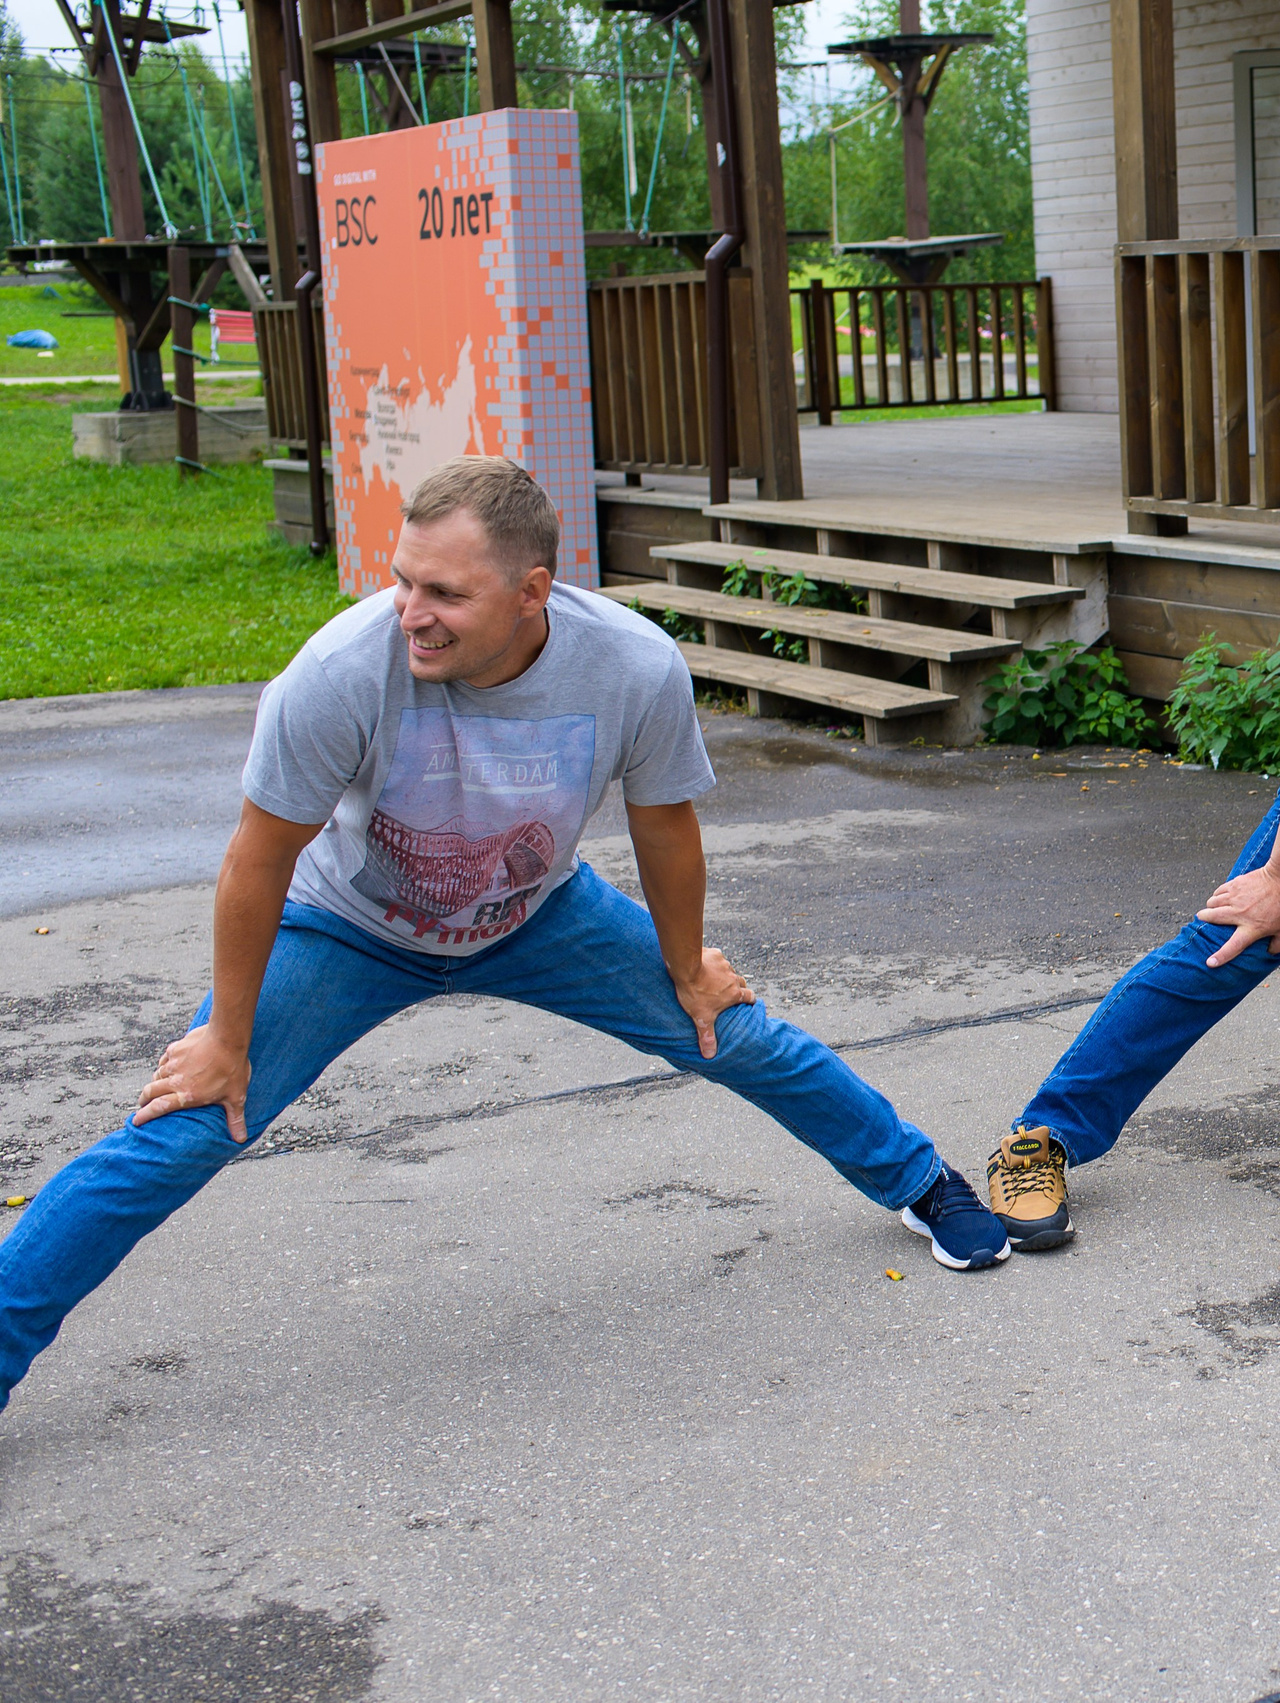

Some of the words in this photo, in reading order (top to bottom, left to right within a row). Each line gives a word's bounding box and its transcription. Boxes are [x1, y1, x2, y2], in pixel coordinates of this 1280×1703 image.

[336, 195, 378, 247] BSC
[418, 186, 443, 240] 20
[451, 192, 493, 238] лет
[426, 752, 558, 783] AMTERDAM
